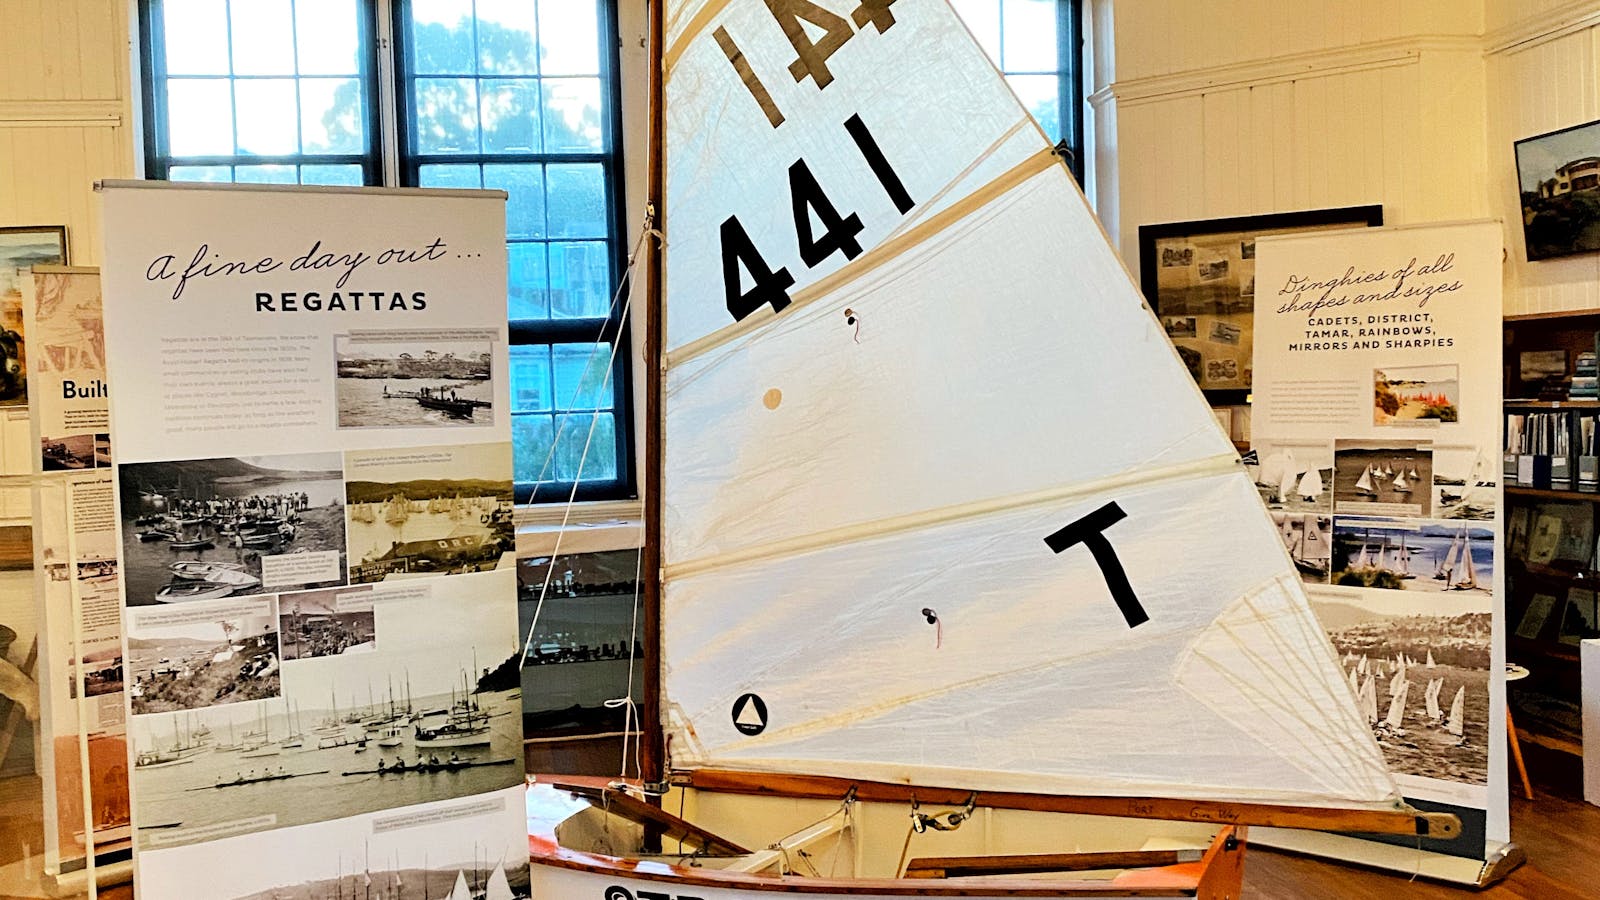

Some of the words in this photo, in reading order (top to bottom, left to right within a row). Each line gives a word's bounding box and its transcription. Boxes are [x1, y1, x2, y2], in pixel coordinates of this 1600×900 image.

[719, 112, 916, 323] 441
[172, 244, 284, 300] fine
[289, 240, 371, 289] day
[1278, 265, 1389, 301] Dinghies
[1391, 257, 1417, 288] of
[1417, 252, 1455, 276] all
[255, 292, 427, 312] REGATTAS
[1276, 292, 1351, 318] shapes
[1352, 282, 1402, 304] and
[1402, 280, 1463, 308] sizes
[1305, 329, 1354, 339] TAMAR,
[1358, 326, 1436, 337] RAINBOWS,
[1308, 316, 1363, 326] CADETS,
[1367, 313, 1434, 324] DISTRICT,
[1288, 341, 1348, 351] MIRRORS
[1352, 340, 1380, 349] AND
[1385, 337, 1454, 349] SHARPIES
[1043, 500, 1150, 629] T
